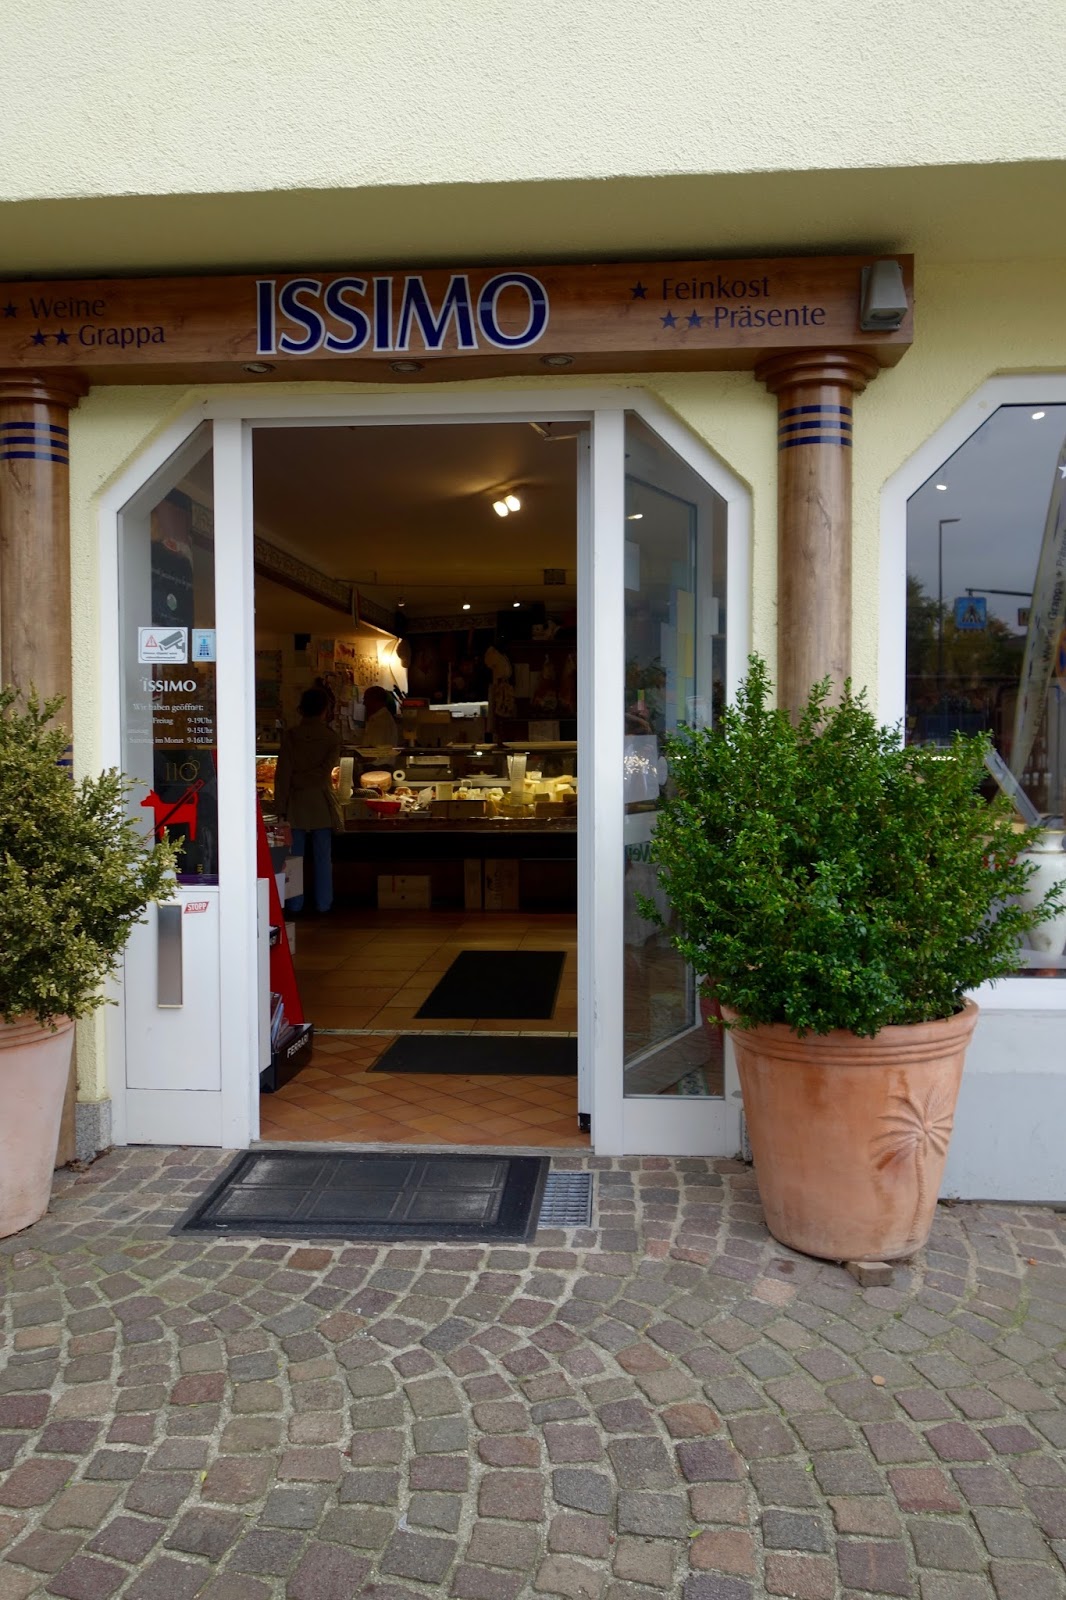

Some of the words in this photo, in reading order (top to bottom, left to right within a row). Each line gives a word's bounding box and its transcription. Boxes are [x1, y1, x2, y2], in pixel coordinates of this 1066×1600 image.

[662, 276, 770, 301] Feinkost
[29, 296, 107, 319] Weine
[255, 271, 549, 356] ISSIMO
[714, 303, 826, 329] Präsente
[79, 323, 166, 349] Grappa
[148, 703, 170, 711] haben
[152, 717, 174, 726] Freitag
[187, 902, 207, 911] STOPP
